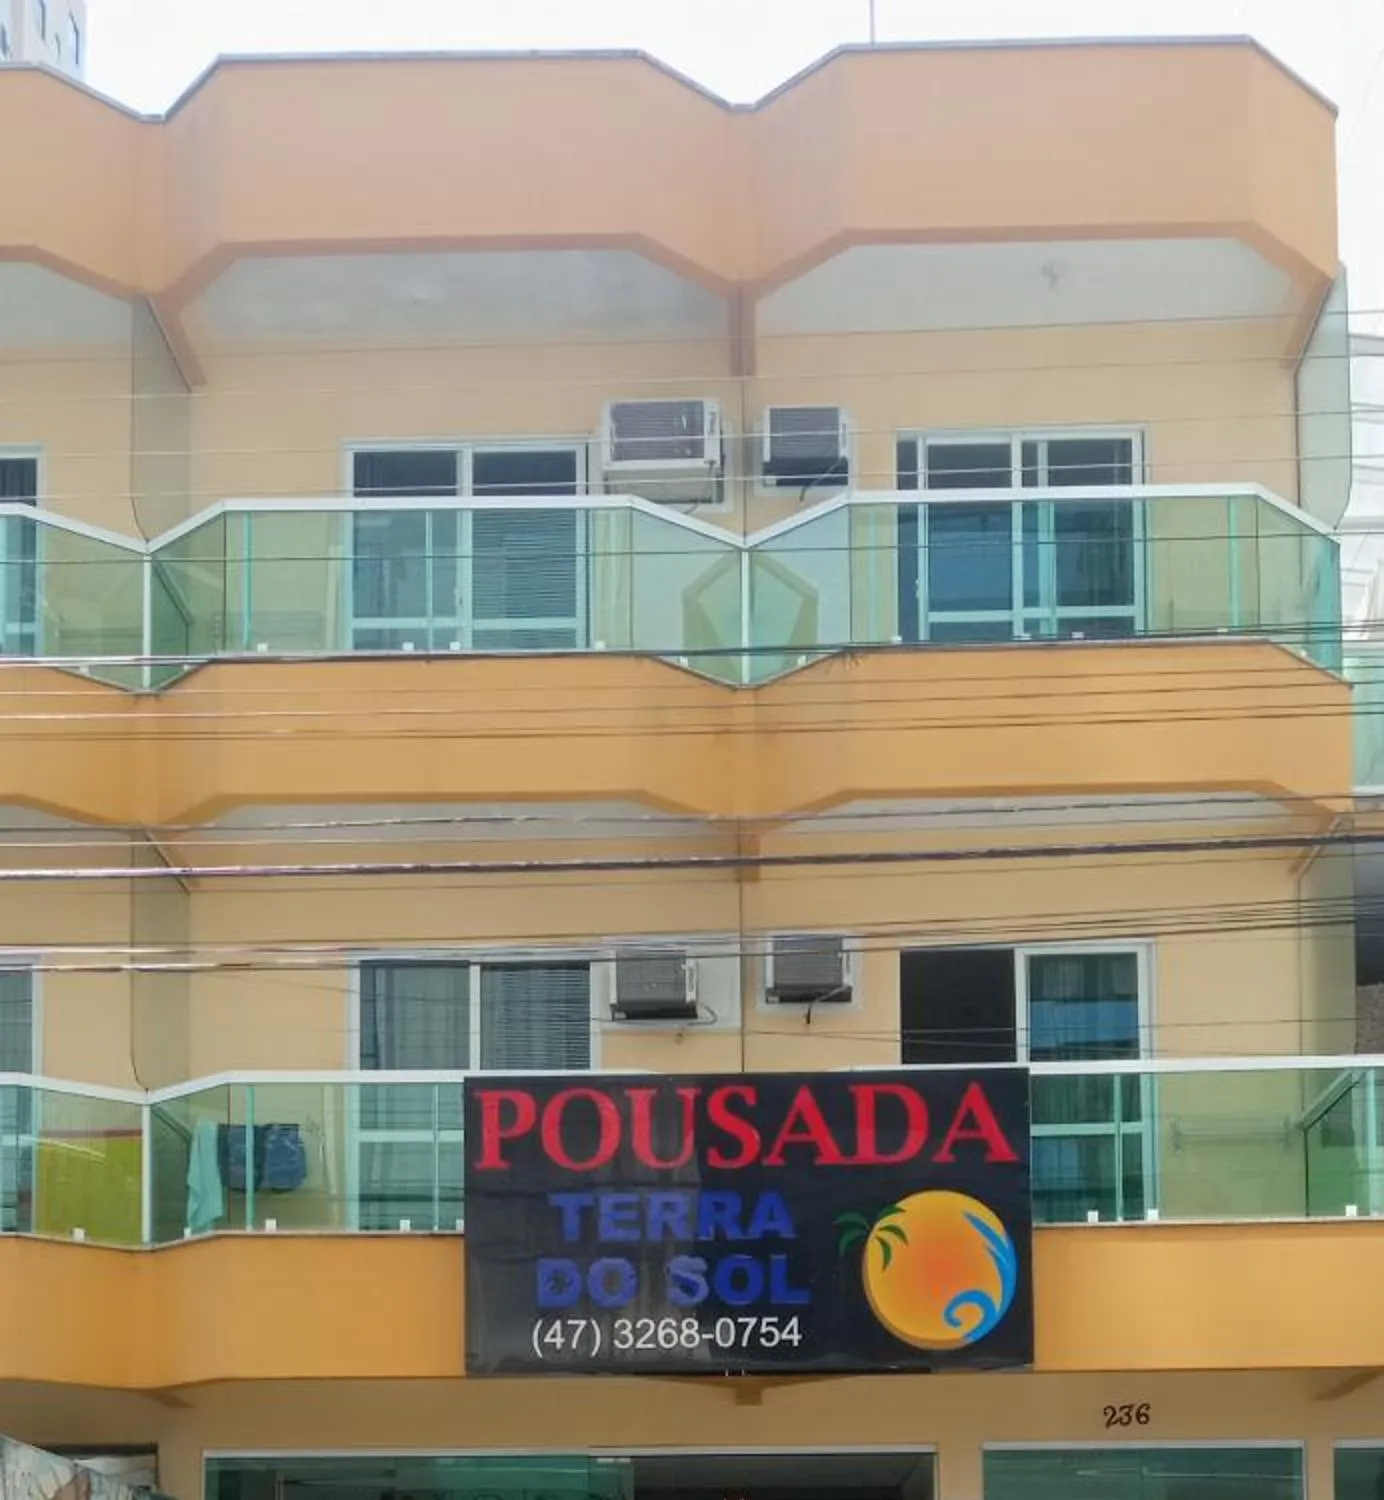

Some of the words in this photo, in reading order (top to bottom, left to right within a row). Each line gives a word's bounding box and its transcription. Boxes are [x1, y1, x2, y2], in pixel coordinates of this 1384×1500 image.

[474, 1082, 1019, 1171] POUSADA
[547, 1189, 798, 1241] TERRA
[536, 1257, 636, 1308] DO
[665, 1254, 810, 1305] SOL
[532, 1319, 601, 1358] (47)
[613, 1316, 802, 1349] 3268-0754
[1103, 1403, 1151, 1429] 236
